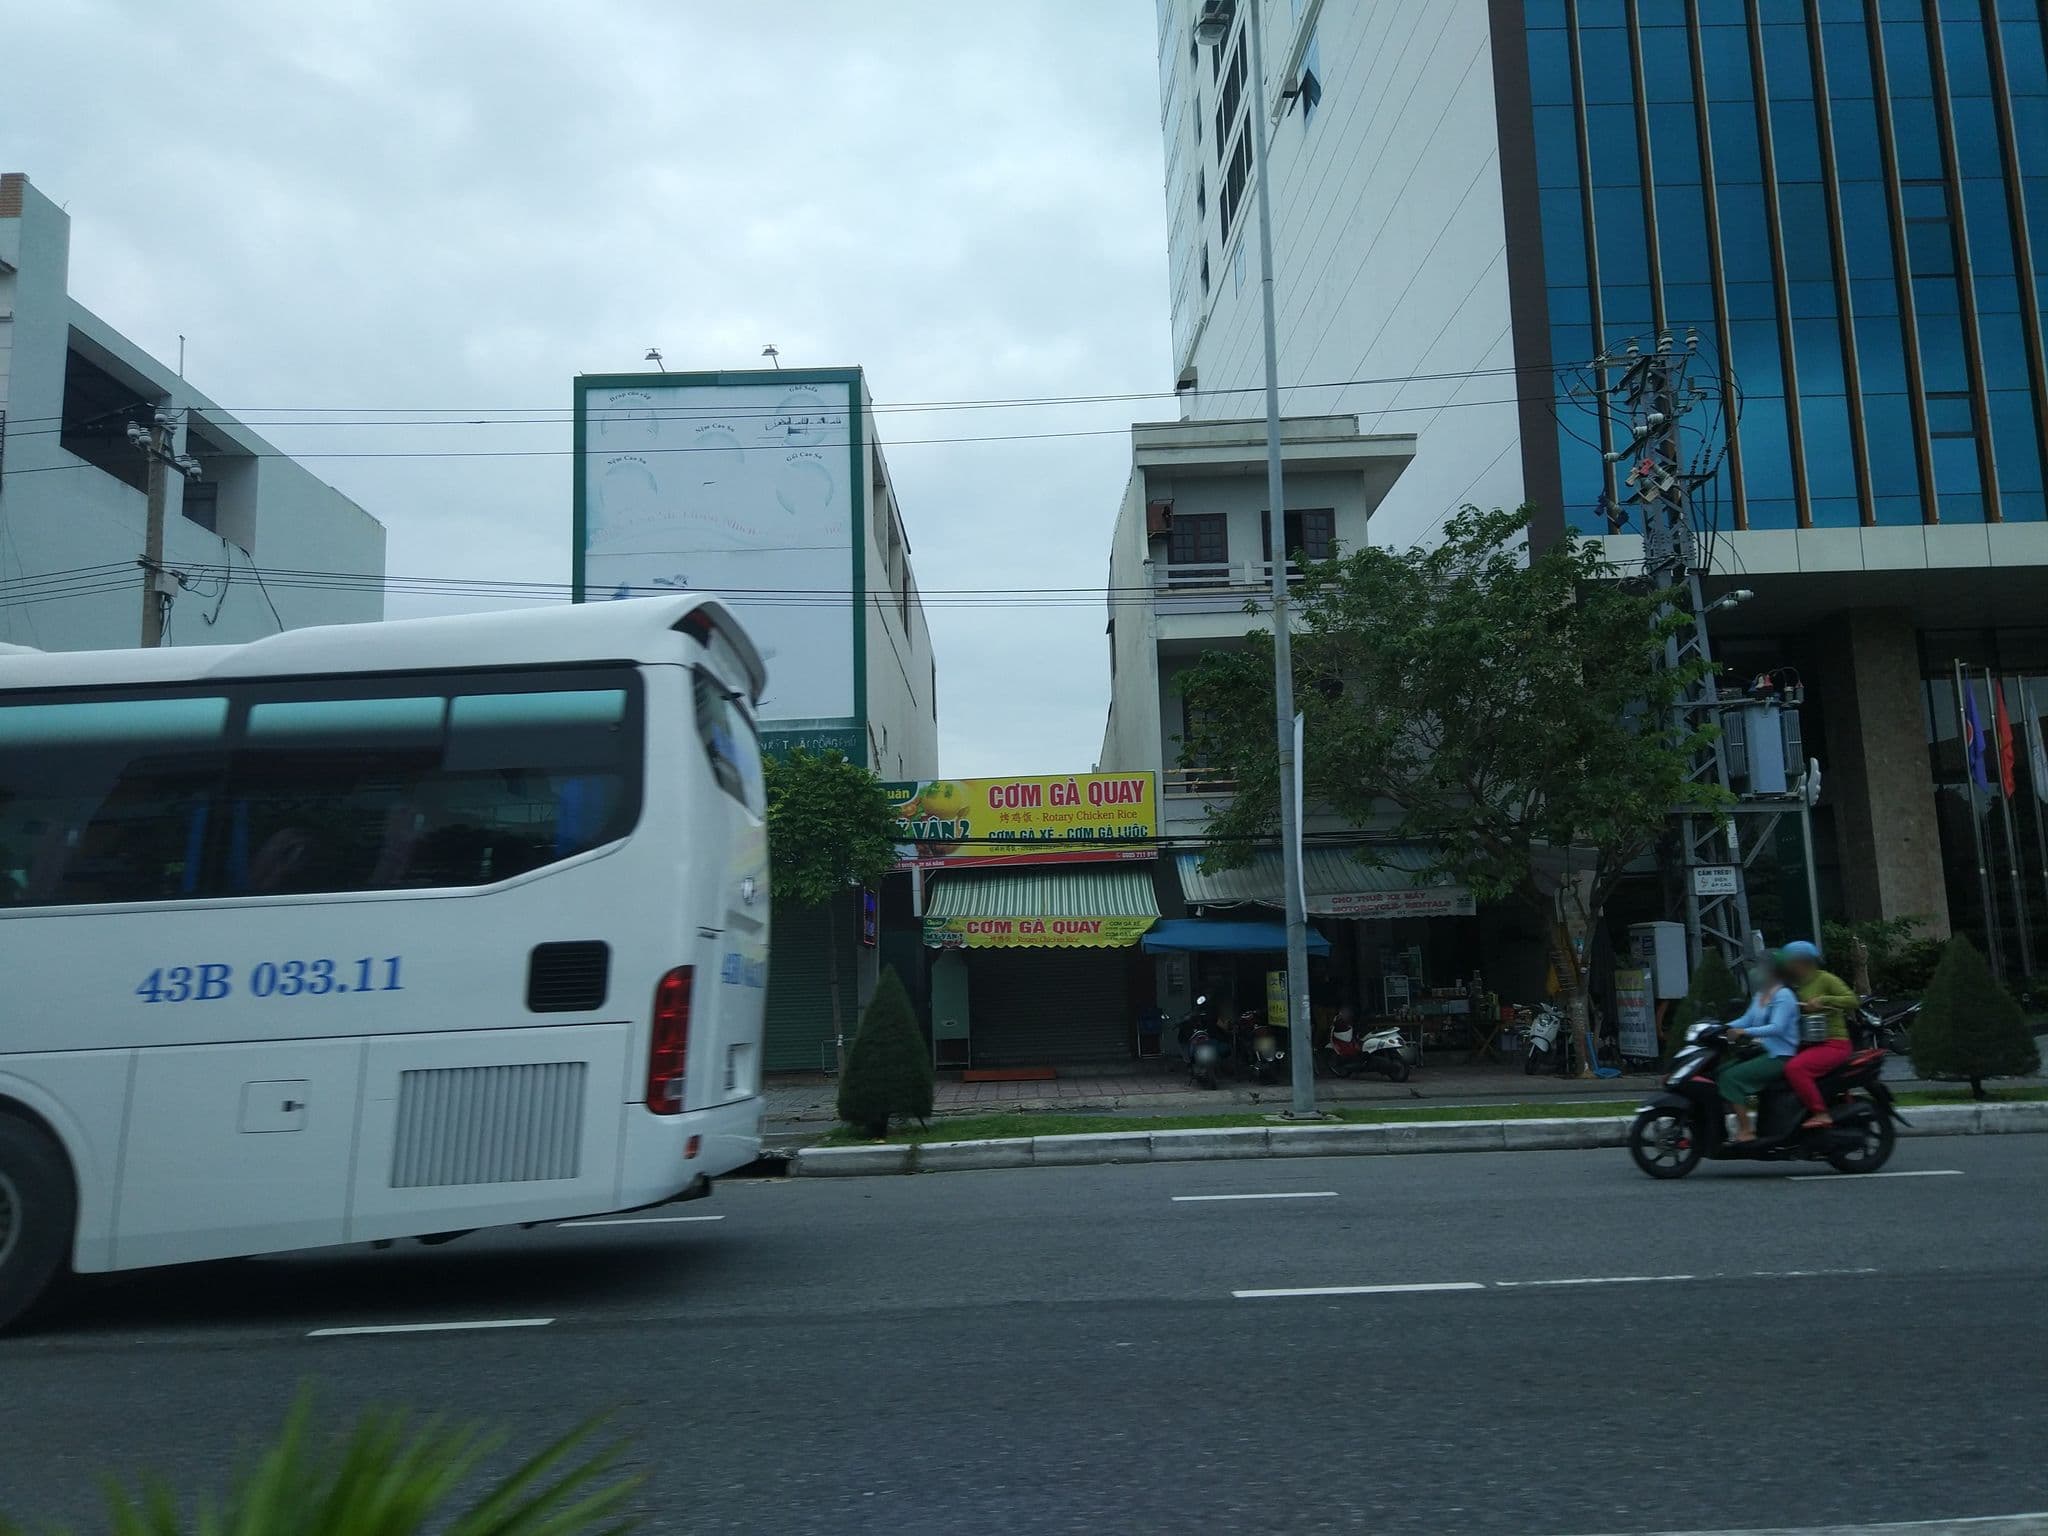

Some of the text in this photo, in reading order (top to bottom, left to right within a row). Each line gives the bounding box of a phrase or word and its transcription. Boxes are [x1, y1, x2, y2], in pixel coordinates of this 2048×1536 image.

[886, 789, 910, 800] uán
[989, 778, 1145, 808] CƠM GÀ QUAY
[1042, 812, 1074, 823] Rotary
[1076, 810, 1115, 821] Chicken
[1117, 810, 1138, 819] Rice
[911, 815, 957, 839] VÂN
[1067, 826, 1094, 838] CƠM
[966, 918, 1102, 935] CƠM GÀ QUAY
[135, 955, 405, 1003] 43B 033.11
